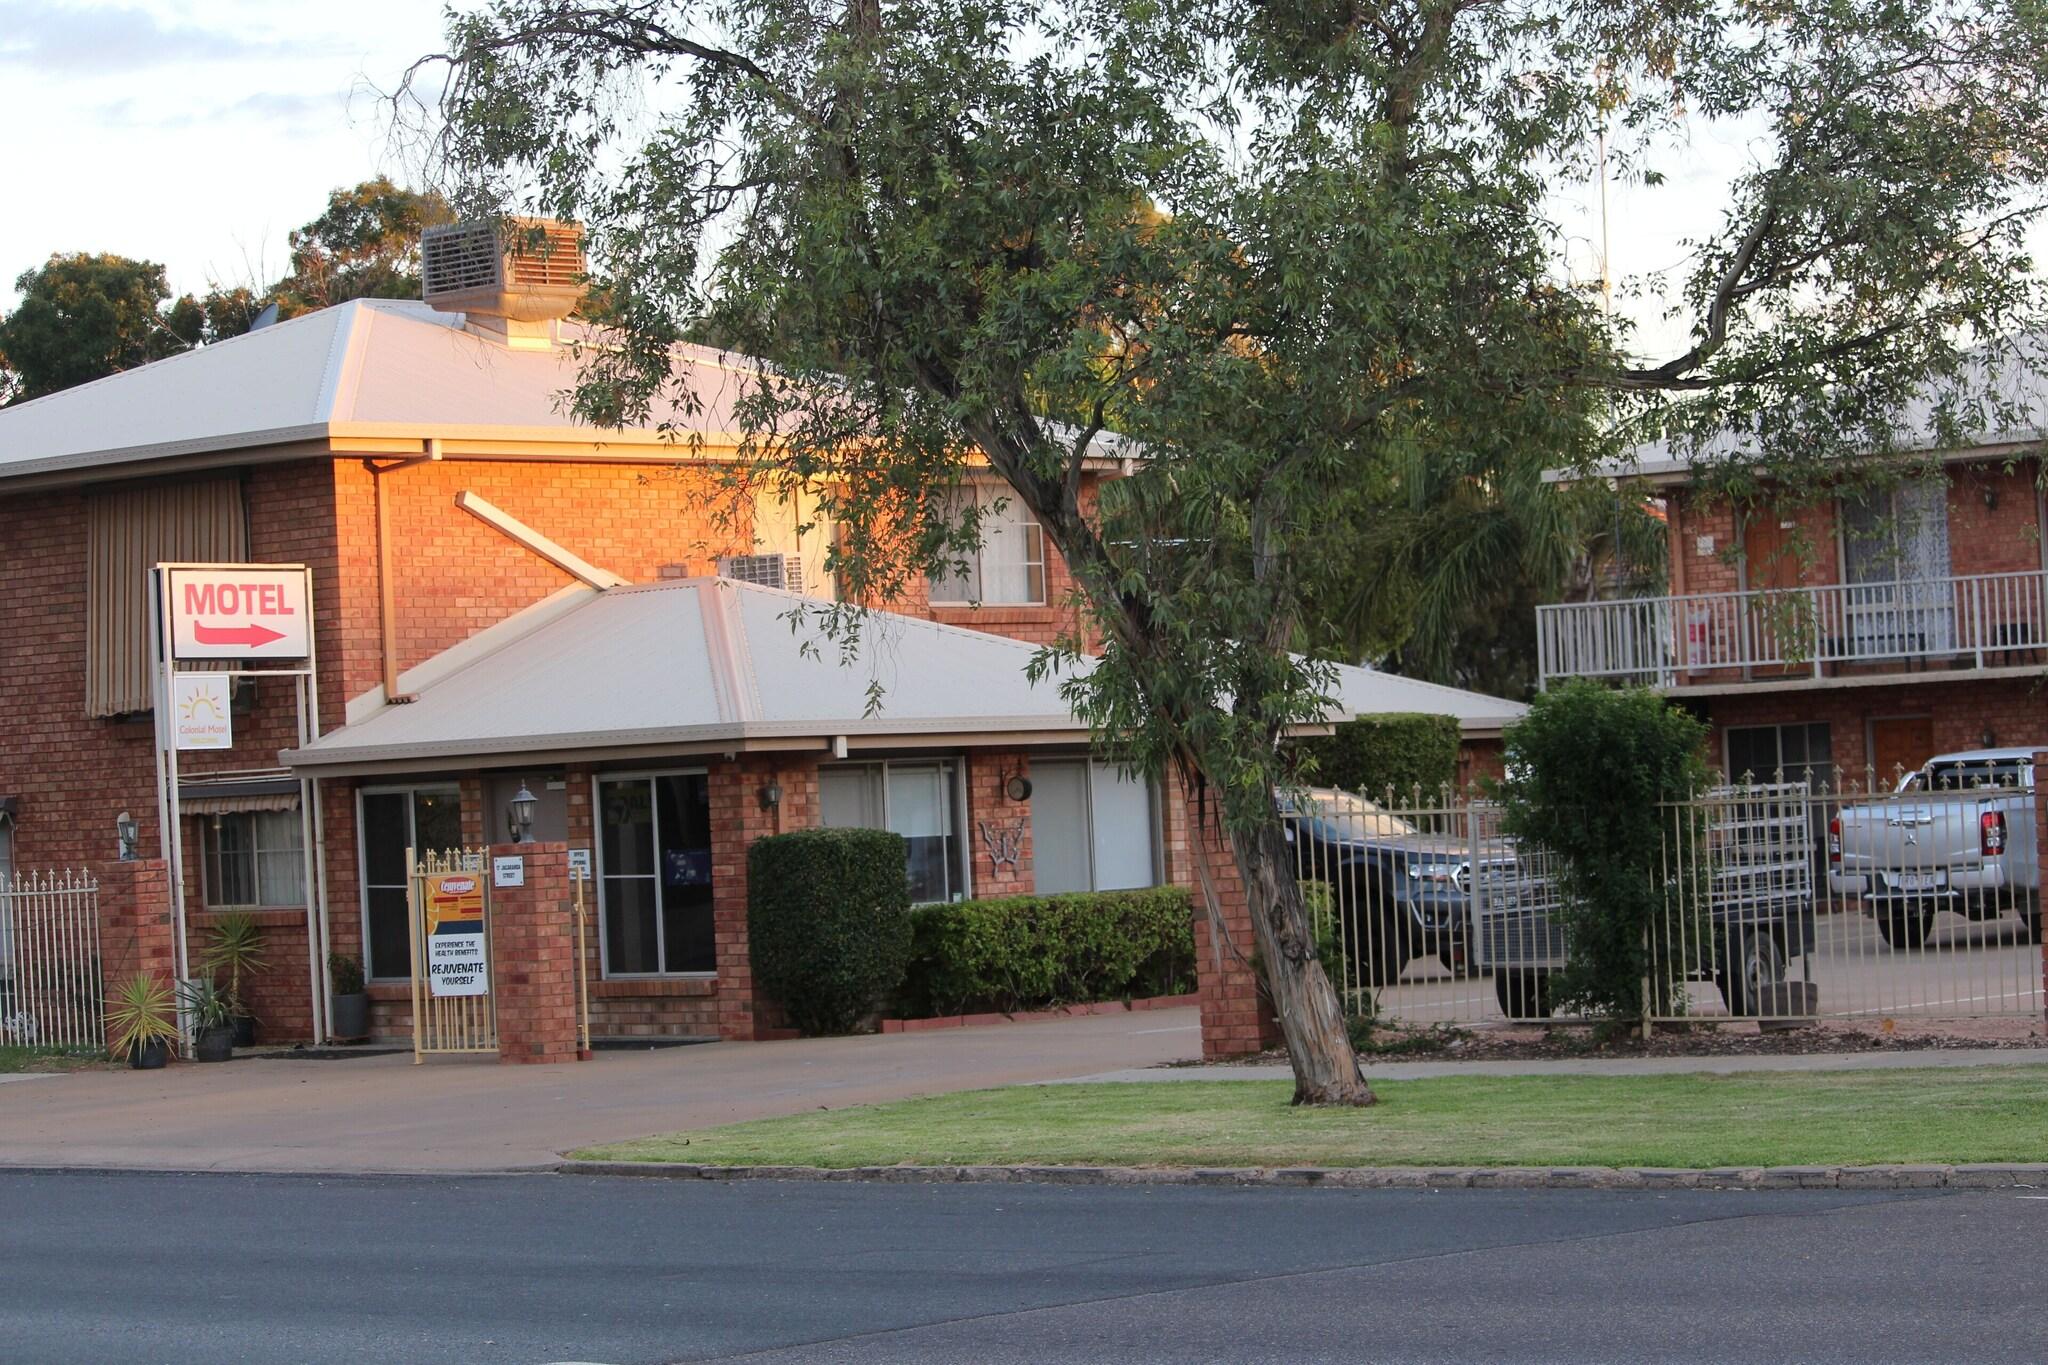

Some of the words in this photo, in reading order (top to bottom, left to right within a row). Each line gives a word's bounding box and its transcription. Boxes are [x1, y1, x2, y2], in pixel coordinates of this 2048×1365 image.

[184, 583, 294, 615] MOTEL
[179, 724, 205, 734] Colonial
[207, 724, 227, 734] Motel
[435, 941, 464, 949] EXPERIENCE
[455, 948, 478, 956] BENEFITS
[432, 962, 484, 974] REJUVENATE
[441, 976, 474, 985] YOURSELF
